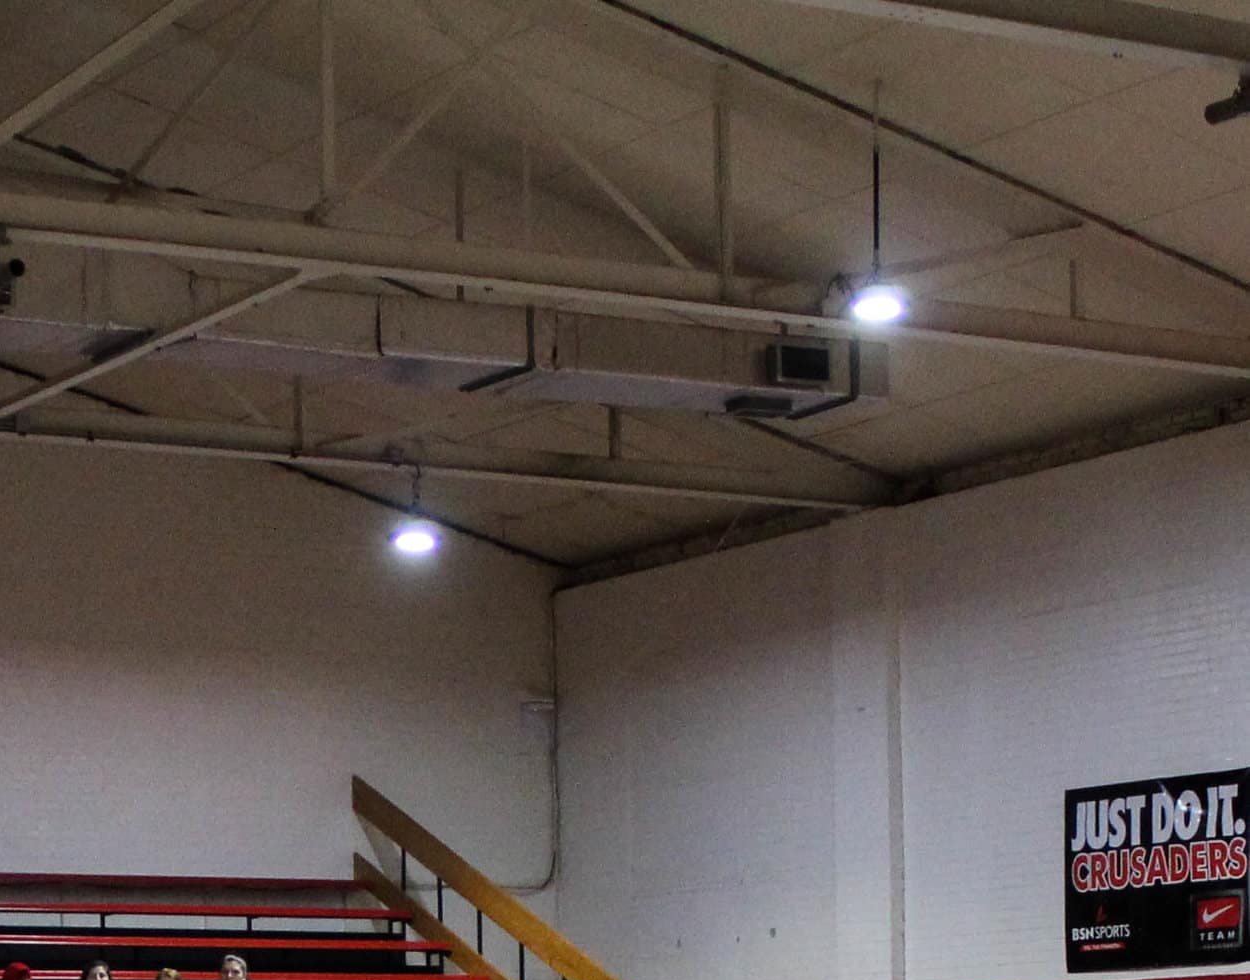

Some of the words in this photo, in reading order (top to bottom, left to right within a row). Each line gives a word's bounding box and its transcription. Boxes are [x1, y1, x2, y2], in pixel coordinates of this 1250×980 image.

[1071, 794, 1146, 852] JUST
[1152, 789, 1202, 845] DO
[1206, 783, 1247, 839] IT.
[1072, 836, 1248, 893] CRUSADERS
[1199, 930, 1237, 941] TEAM
